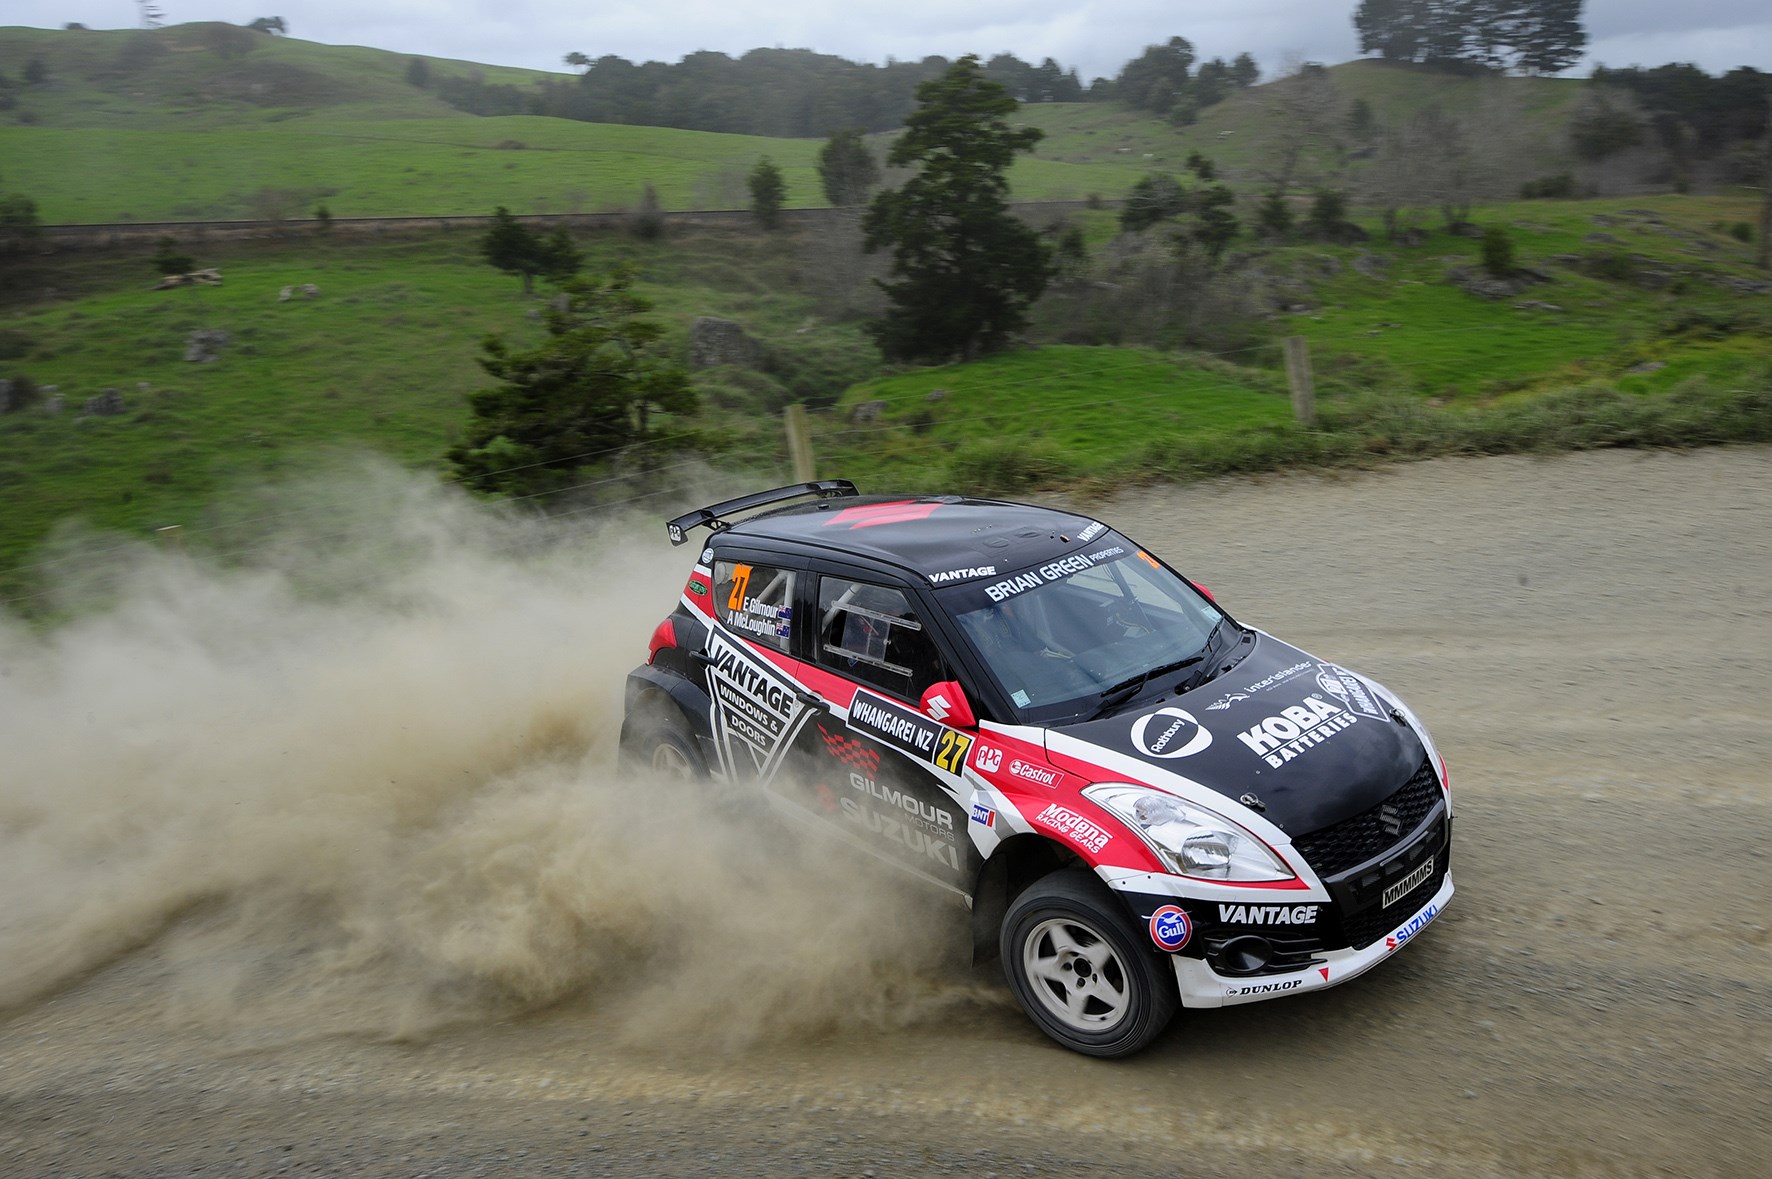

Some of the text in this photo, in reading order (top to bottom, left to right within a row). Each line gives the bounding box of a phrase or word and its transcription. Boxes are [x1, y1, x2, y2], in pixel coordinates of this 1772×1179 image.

[728, 563, 752, 611] 27
[928, 566, 997, 583] VANTAGE
[984, 546, 1124, 602] BRIAN GREEN PROPERTIES
[727, 610, 775, 636] A McLoughlin
[743, 596, 778, 618] E Gilmour
[714, 645, 794, 719] VANTAGE
[1244, 661, 1312, 693] interislander
[720, 684, 778, 733] WINDOWS &
[1237, 696, 1342, 756] KOBA
[731, 715, 766, 746] DOORS
[852, 699, 970, 774] WHANGAREI NZ 27
[1150, 719, 1185, 753] Rothbury
[1265, 712, 1358, 769] BATTERIES
[1020, 764, 1056, 785] Castrol
[850, 772, 953, 830] GILMOUR
[972, 807, 988, 823] BNT
[840, 797, 960, 871] SUZUKI
[904, 813, 955, 841] MOTORS
[1036, 813, 1101, 854] RACING GEARS
[1041, 803, 1109, 848] Modena
[1158, 922, 1185, 938] Gull
[1218, 904, 1318, 924] VANTAGE
[1396, 904, 1438, 944] SUZUKI
[1240, 980, 1302, 995] DUNLOP
